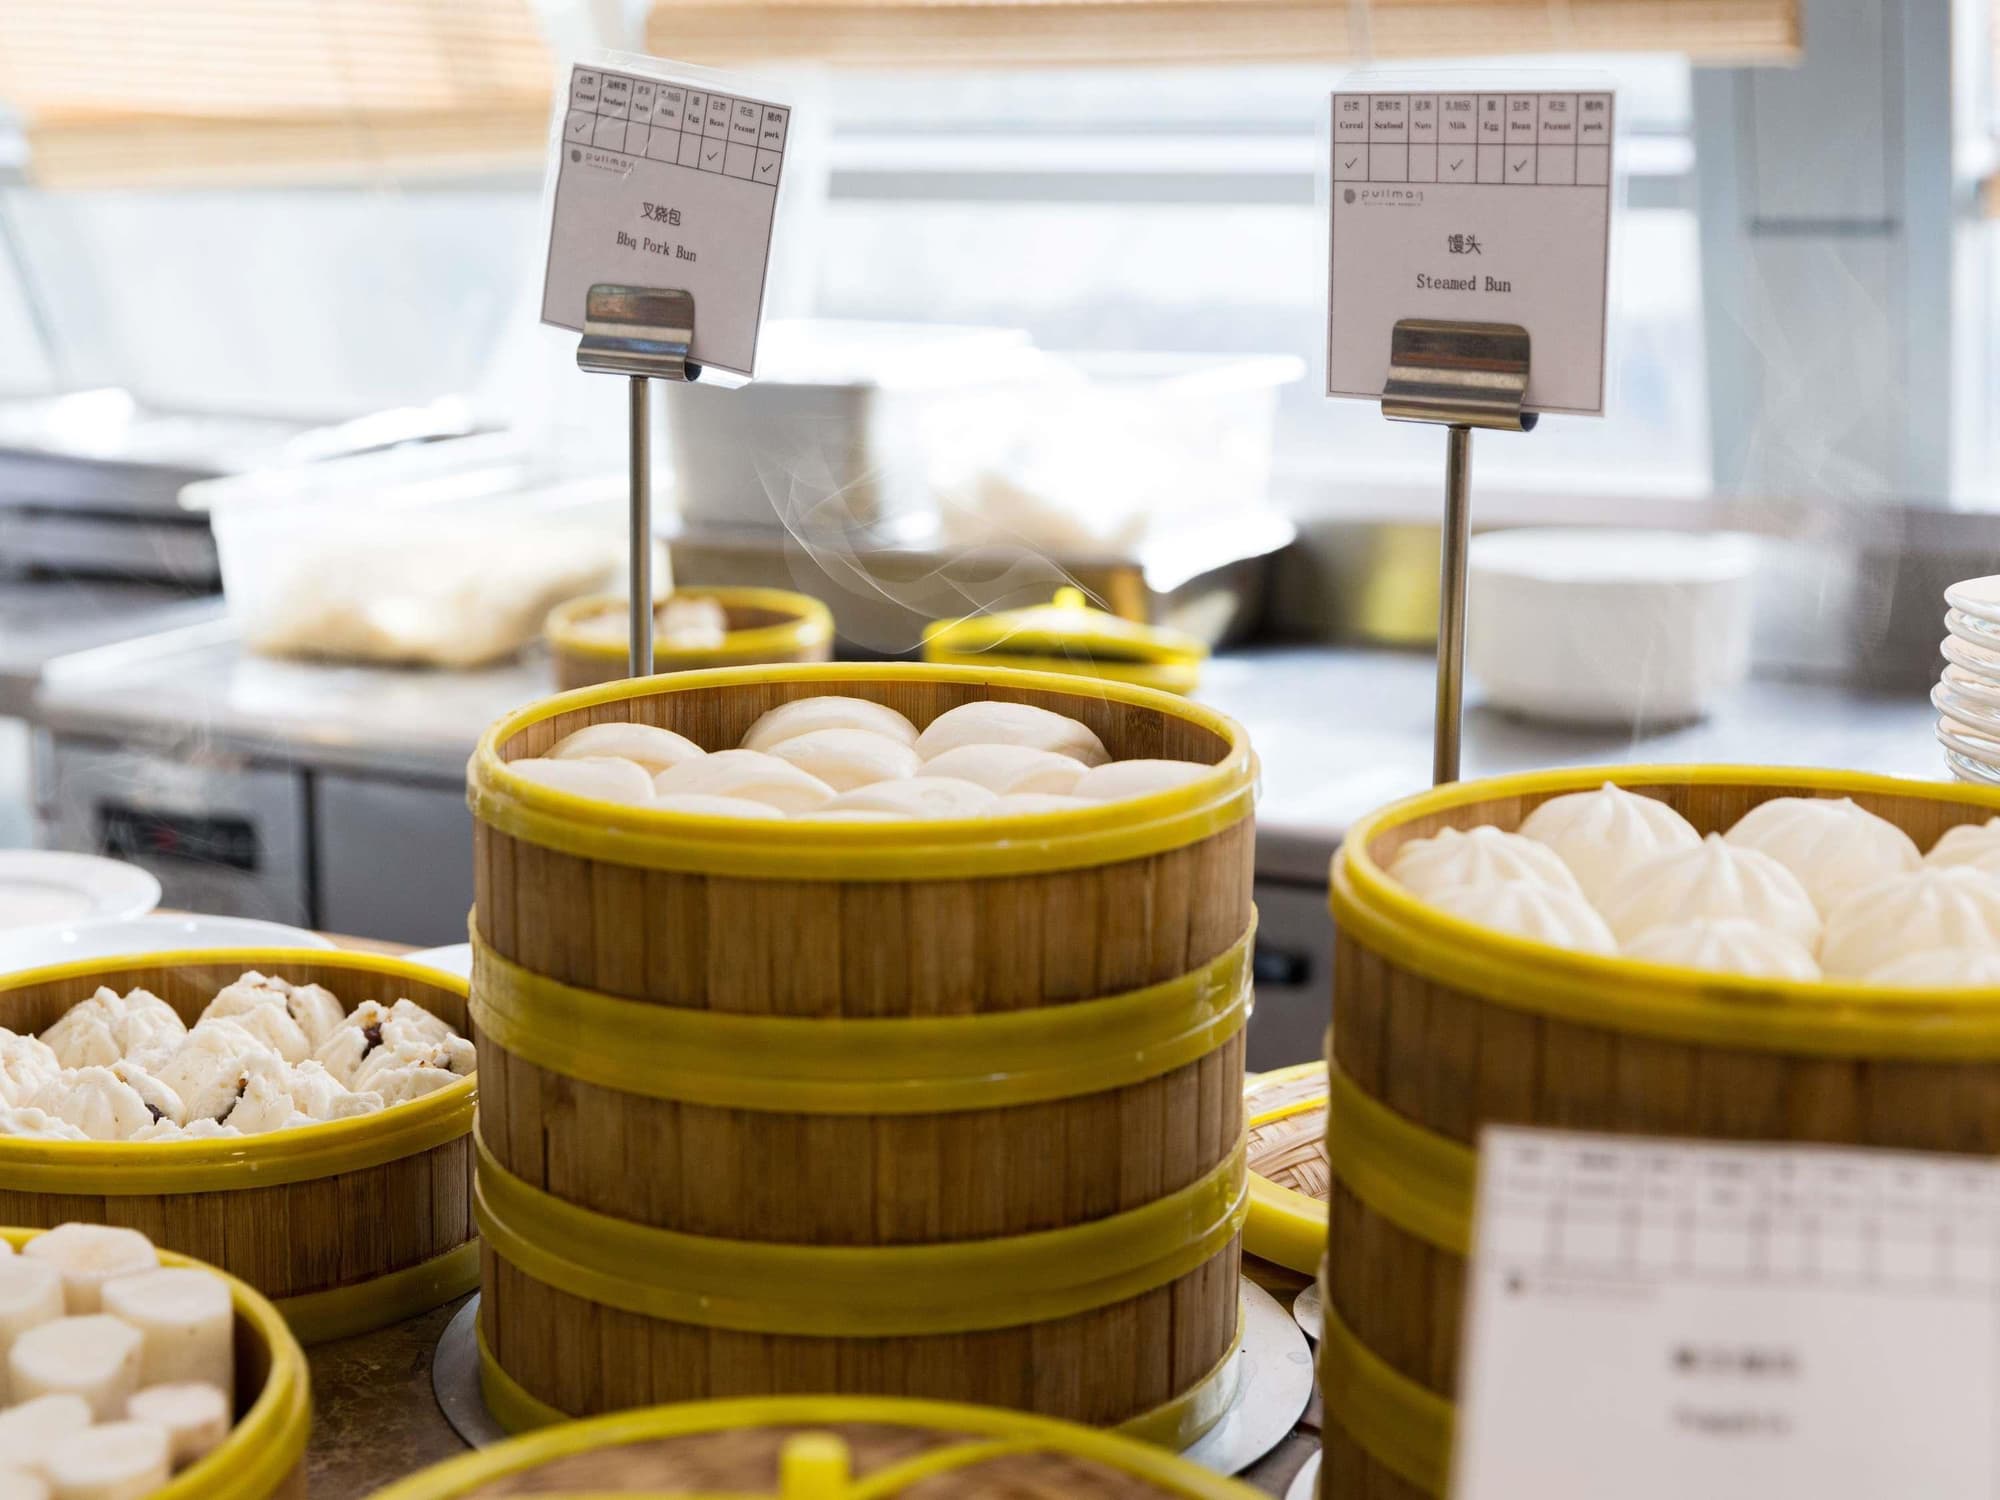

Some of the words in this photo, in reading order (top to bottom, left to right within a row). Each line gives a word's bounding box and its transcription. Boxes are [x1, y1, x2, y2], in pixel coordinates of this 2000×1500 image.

[688, 113, 701, 124] Egg
[709, 118, 725, 128] Bean
[734, 123, 756, 135] Peanut
[764, 131, 780, 140] pork
[1340, 121, 1364, 129] Cereal
[1374, 121, 1404, 130] Seafood
[1415, 121, 1432, 130] Nuts
[1449, 121, 1467, 130] Milk
[1484, 121, 1499, 132] Egg
[1512, 121, 1531, 130] Bean
[1544, 121, 1571, 130] Peanut
[1584, 121, 1603, 132] pork
[640, 201, 682, 227] 叉烧包
[616, 231, 637, 251] Bbq
[643, 237, 670, 256] Pork
[675, 245, 697, 262] Bun
[1448, 233, 1482, 255] 馒头
[1416, 273, 1476, 290] Steamed
[1485, 276, 1512, 292] Bun
